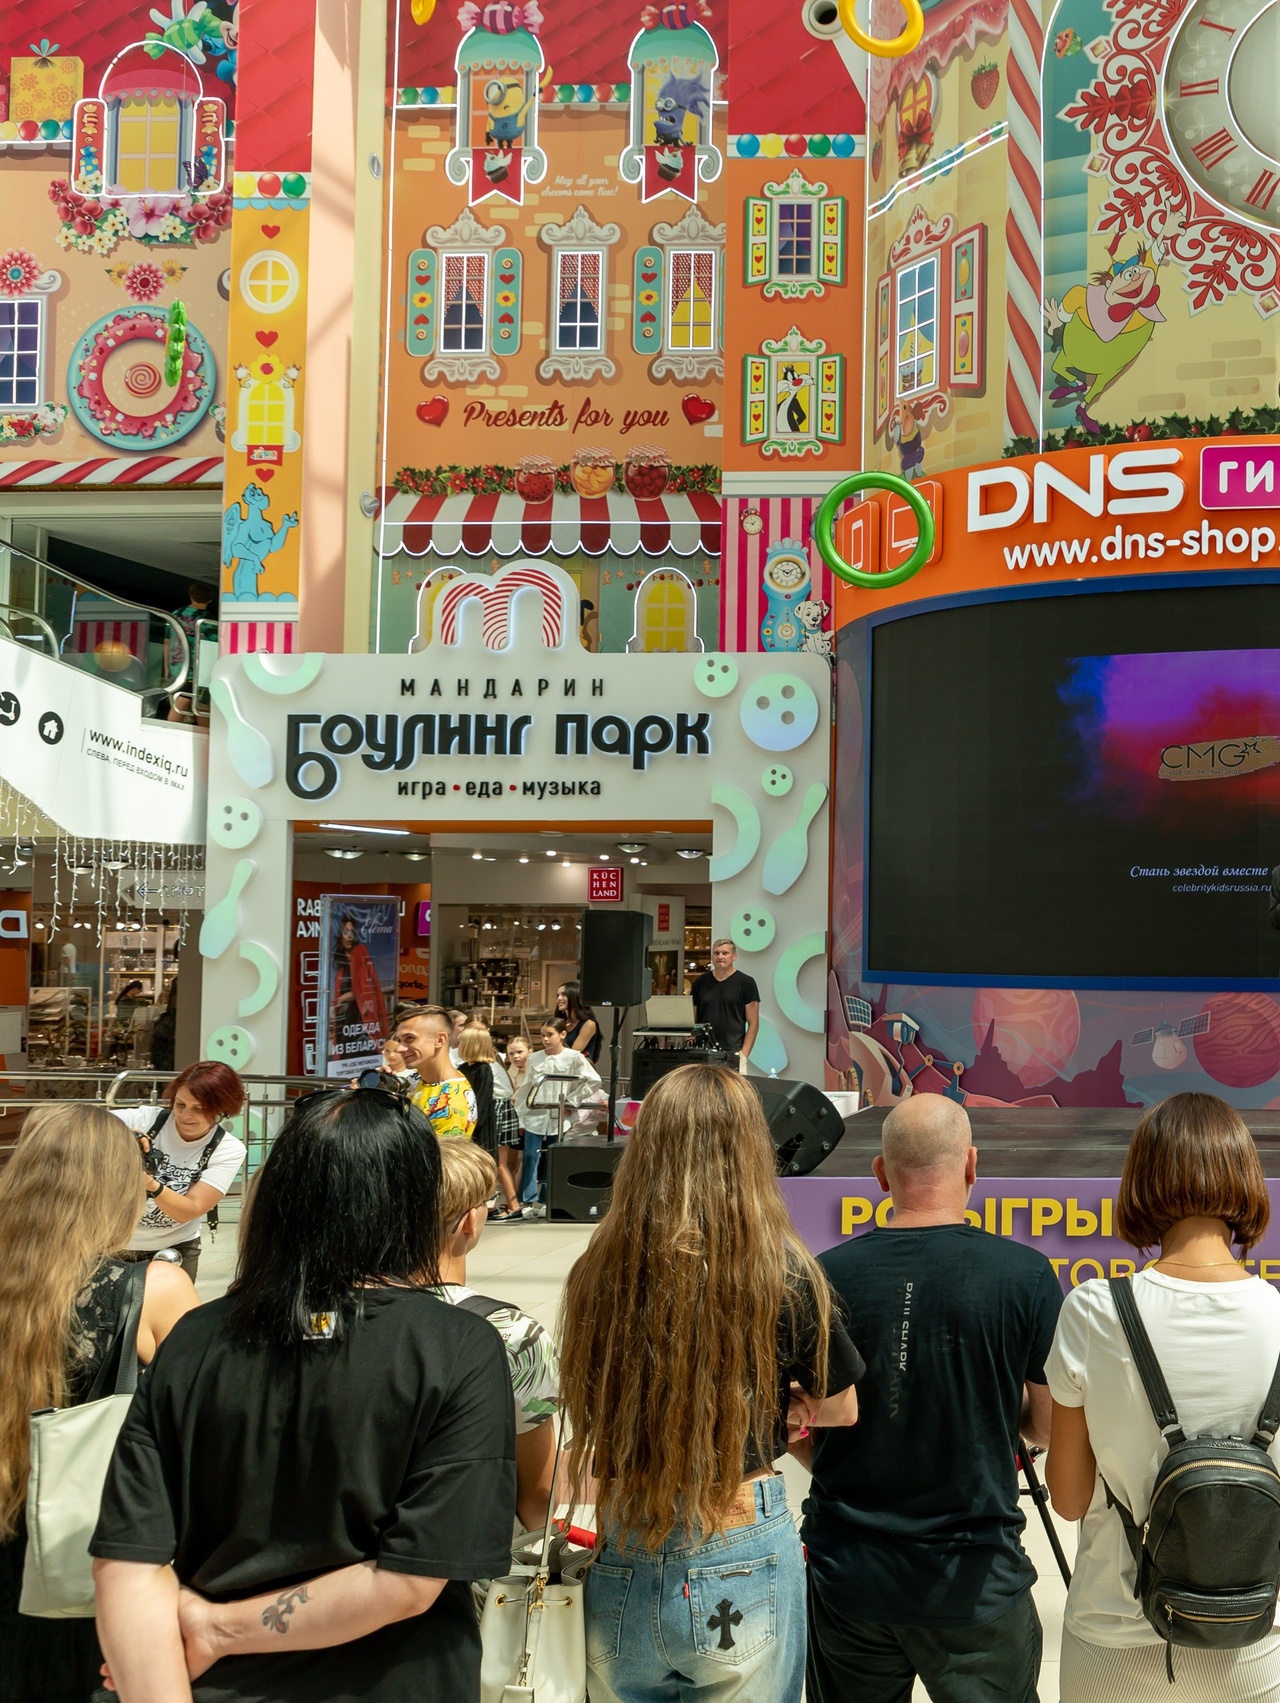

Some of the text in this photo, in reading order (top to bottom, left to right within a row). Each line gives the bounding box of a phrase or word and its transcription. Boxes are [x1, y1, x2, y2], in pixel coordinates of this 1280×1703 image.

[463, 397, 670, 435] Presents for you
[967, 447, 1185, 533] DNS
[400, 678, 605, 699] МАНДАРИН
[555, 712, 710, 770] парк
[89, 729, 189, 778] www.indexiq.ru
[1161, 744, 1247, 769] CMG
[112, 757, 135, 773] ПЕРЕД
[136, 766, 163, 784] ВХОДОМ
[1163, 769, 1195, 777] Celebrity
[1222, 768, 1245, 777] Group
[398, 779, 602, 800] игра еда музыка
[593, 871, 617, 880] KÜC
[1130, 864, 1269, 878] Стань звездой вместе
[1172, 882, 1272, 894] celebritykidsrussia.ru
[343, 1021, 380, 1037] ОДЕЖДА
[331, 1039, 386, 1056] ИЗ БЕЛАРУС
